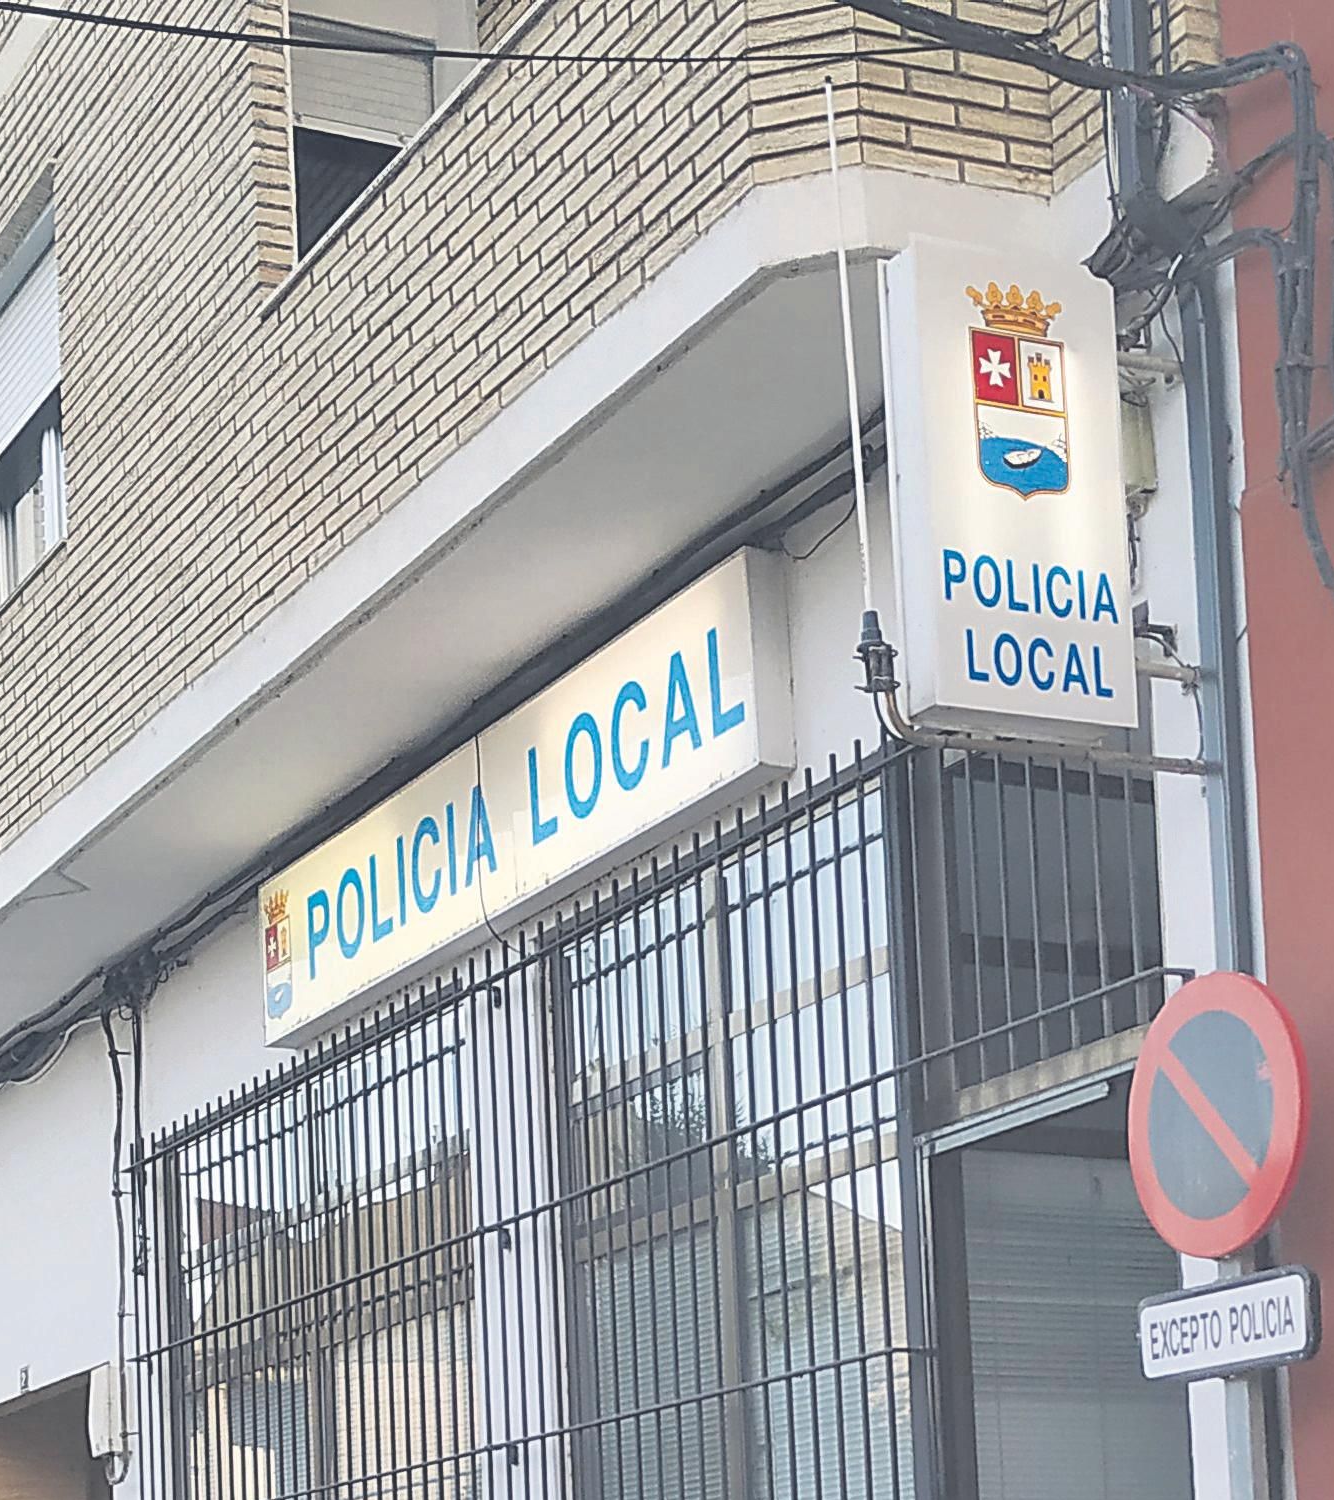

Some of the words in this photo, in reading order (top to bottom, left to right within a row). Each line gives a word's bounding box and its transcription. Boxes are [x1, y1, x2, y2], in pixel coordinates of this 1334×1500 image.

[942, 548, 1120, 624] POLICIA
[965, 627, 1114, 699] LOCAL
[306, 784, 498, 980] POLICIA
[528, 627, 746, 846] LOCAL
[1150, 1309, 1223, 1361] EXCEPTO
[1230, 1295, 1295, 1345] POLICIA
